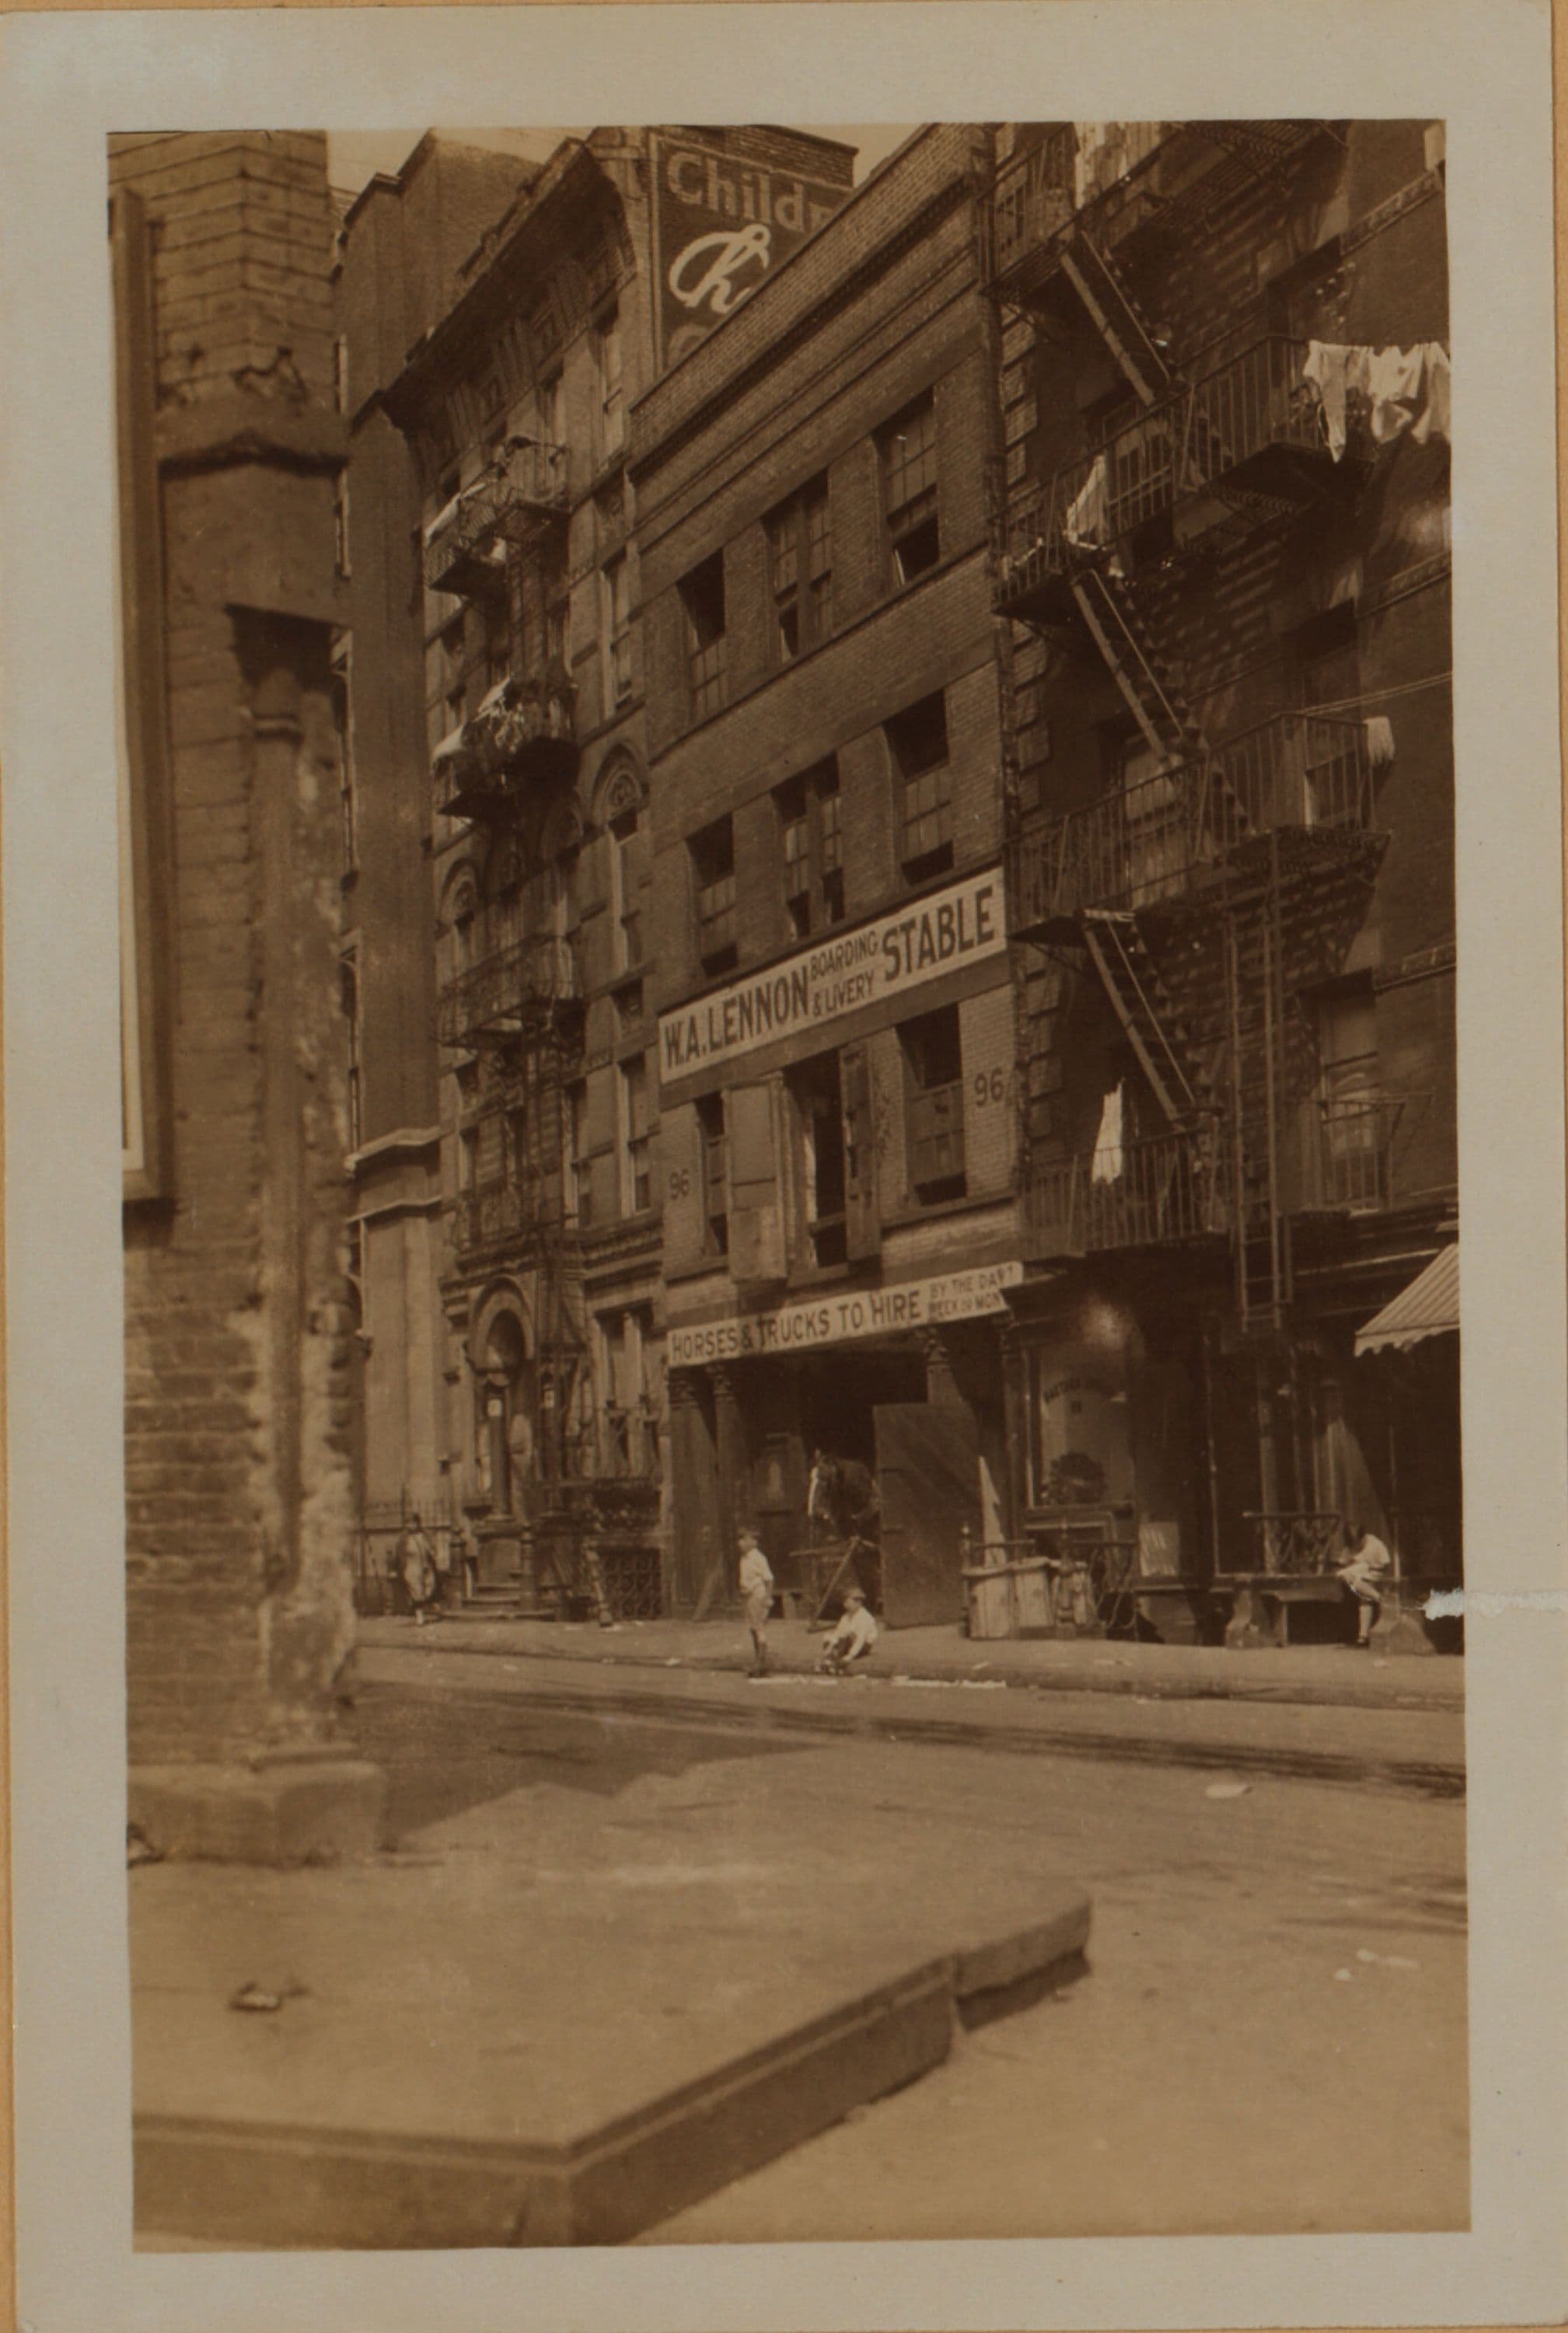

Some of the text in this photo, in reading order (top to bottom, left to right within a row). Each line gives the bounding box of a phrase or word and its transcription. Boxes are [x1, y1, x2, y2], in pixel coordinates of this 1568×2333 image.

[882, 885, 995, 982] STABLE
[810, 930, 878, 981] BOARDING
[825, 969, 874, 1011] LIVERY
[975, 1067, 1003, 1108] 96
[670, 1168, 690, 1200] 96
[929, 1281, 946, 1299] BY
[951, 1276, 974, 1294] THE
[672, 1326, 737, 1364] HORSES
[756, 1308, 830, 1347] TRUCKS
[838, 1301, 864, 1332] TO
[869, 1290, 921, 1325] HIRE
